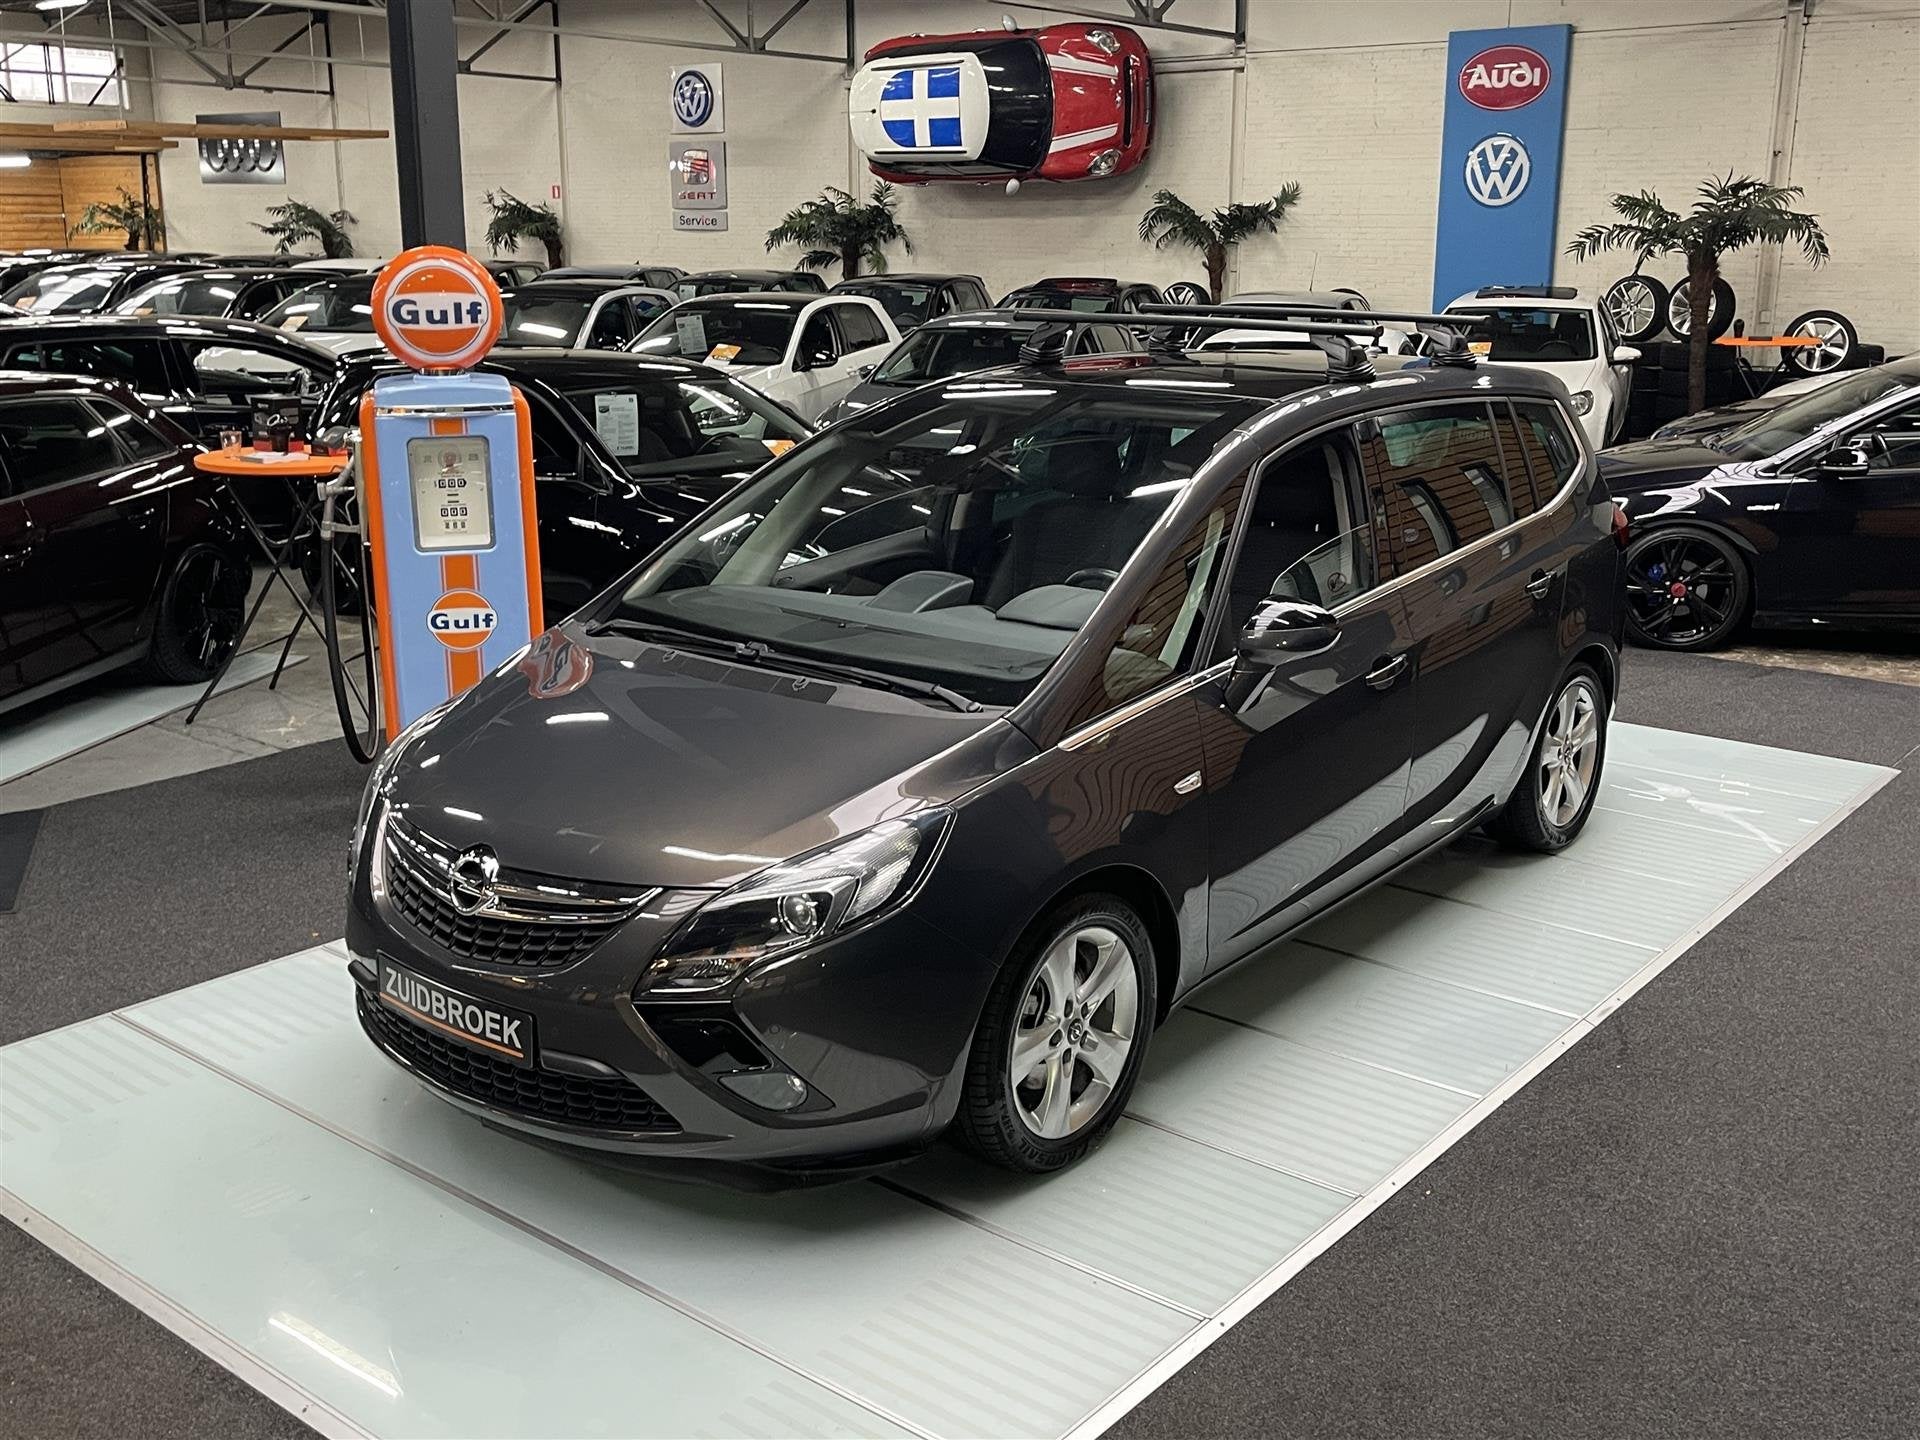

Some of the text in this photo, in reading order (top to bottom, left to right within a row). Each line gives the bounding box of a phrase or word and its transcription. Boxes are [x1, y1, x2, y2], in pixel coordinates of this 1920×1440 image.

[679, 191, 717, 200] SEAT
[679, 215, 718, 226] Service
[391, 298, 482, 325] Gulf
[430, 612, 494, 630] Gulf
[385, 966, 522, 1049] ZUIDBROEK
